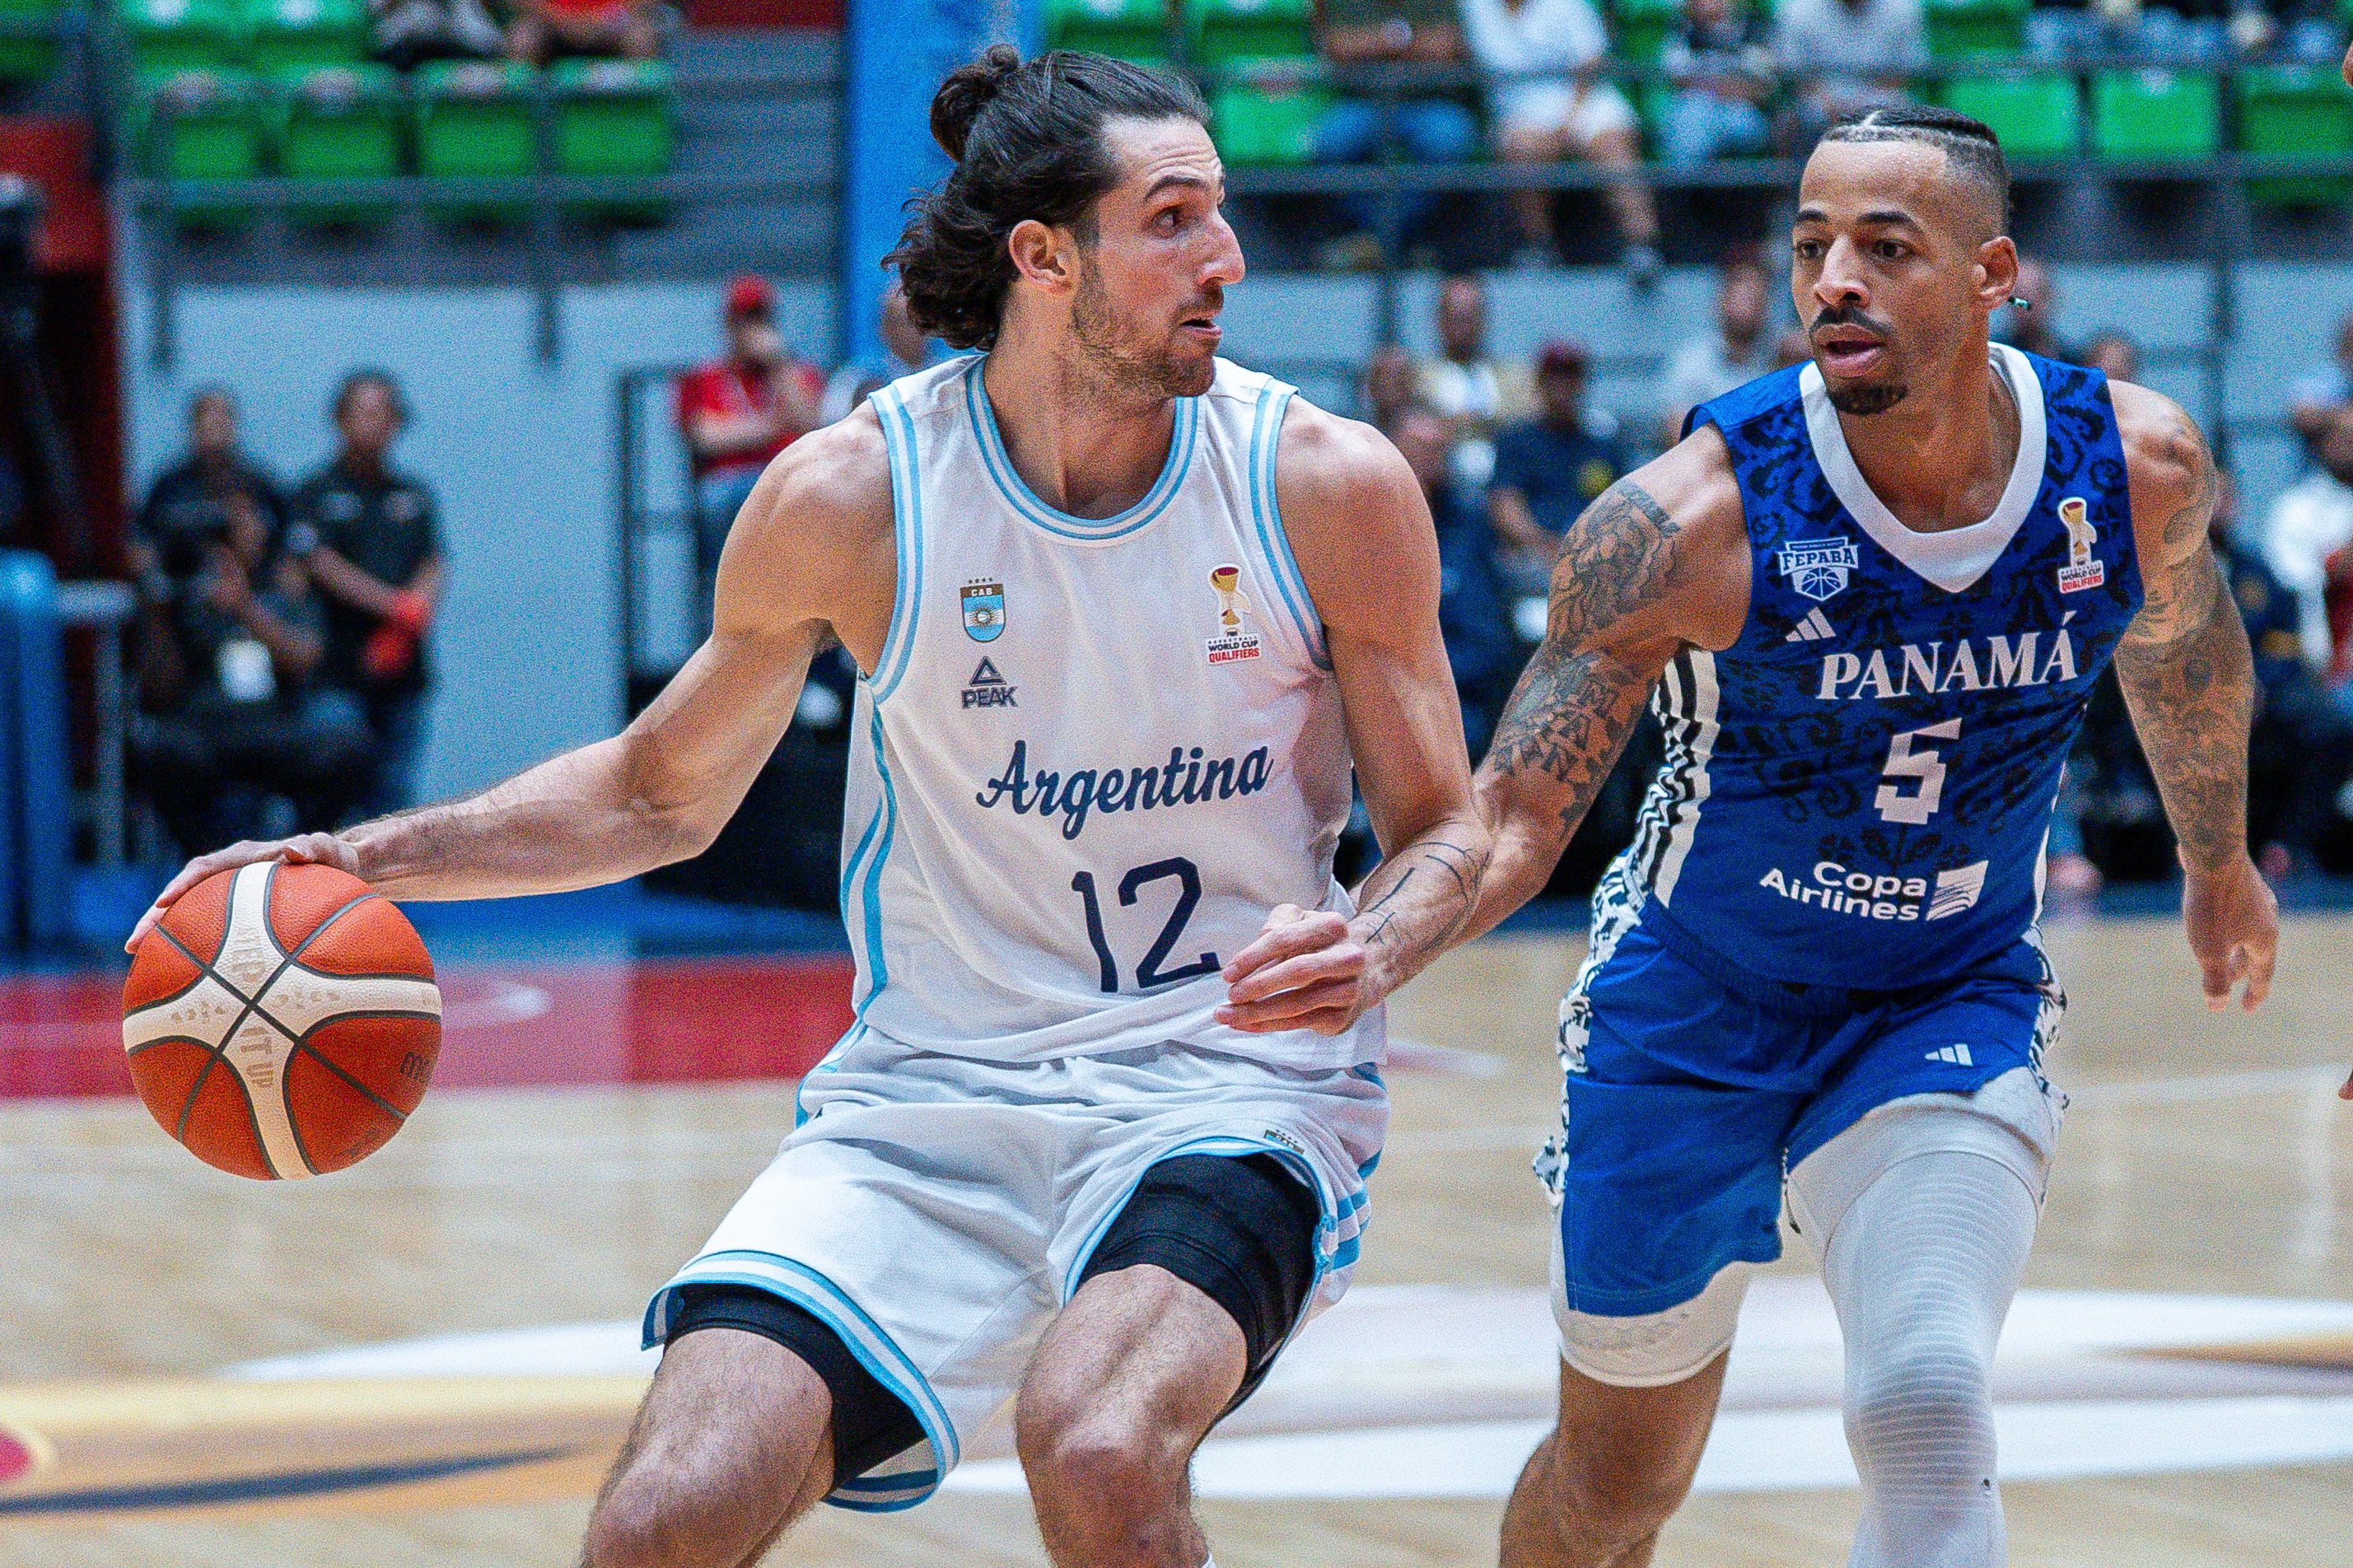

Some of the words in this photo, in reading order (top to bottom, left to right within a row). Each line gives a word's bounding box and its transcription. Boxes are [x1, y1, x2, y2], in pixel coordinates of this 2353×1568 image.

[1781, 548, 1856, 572] FEPABA
[970, 586, 994, 597] CAB
[1207, 642, 1240, 652] WORLD
[1241, 639, 1259, 648] CUP
[1208, 647, 1260, 663] QUALIFIERS
[1814, 609, 2078, 700] PANAMÁ
[960, 685, 1019, 710] PEAK
[976, 739, 1274, 841] Argentina
[1873, 716, 1963, 825] 5
[1758, 867, 1921, 922] Airlines
[1813, 860, 1927, 900] Copa
[1071, 856, 1222, 993] 12
